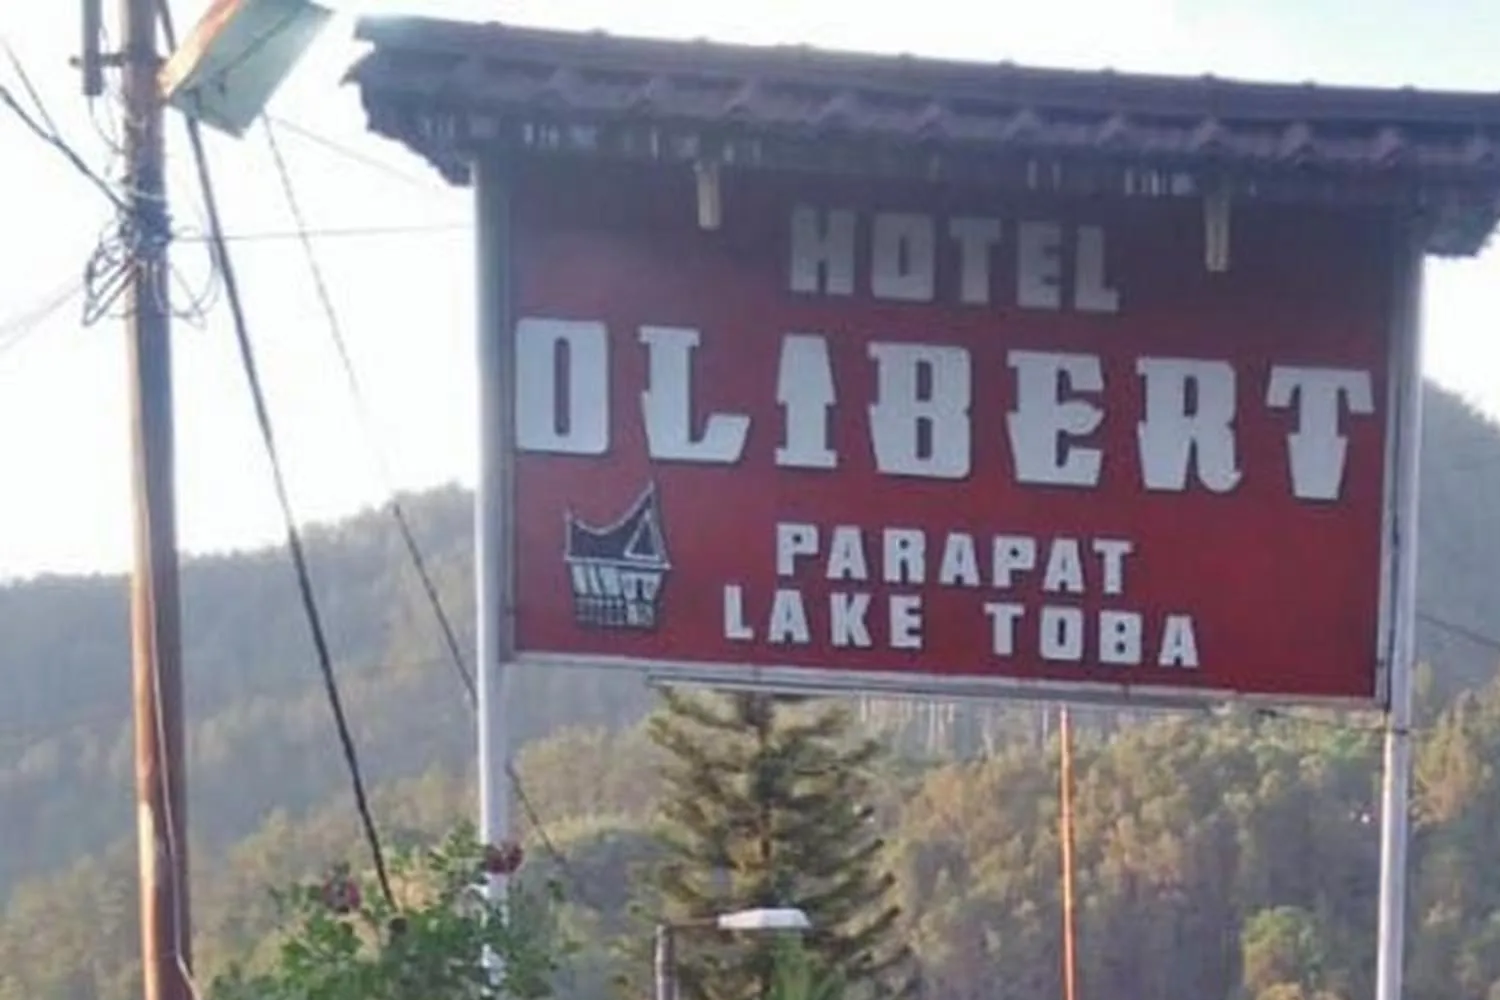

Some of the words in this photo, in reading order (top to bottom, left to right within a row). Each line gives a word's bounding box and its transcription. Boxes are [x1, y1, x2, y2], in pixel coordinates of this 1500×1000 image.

[789, 207, 1121, 312] HOTEL
[515, 318, 1375, 500] OLIBERT
[776, 522, 1133, 594] PARAPAT
[723, 586, 924, 649] LAKE
[985, 603, 1199, 668] TOBA
